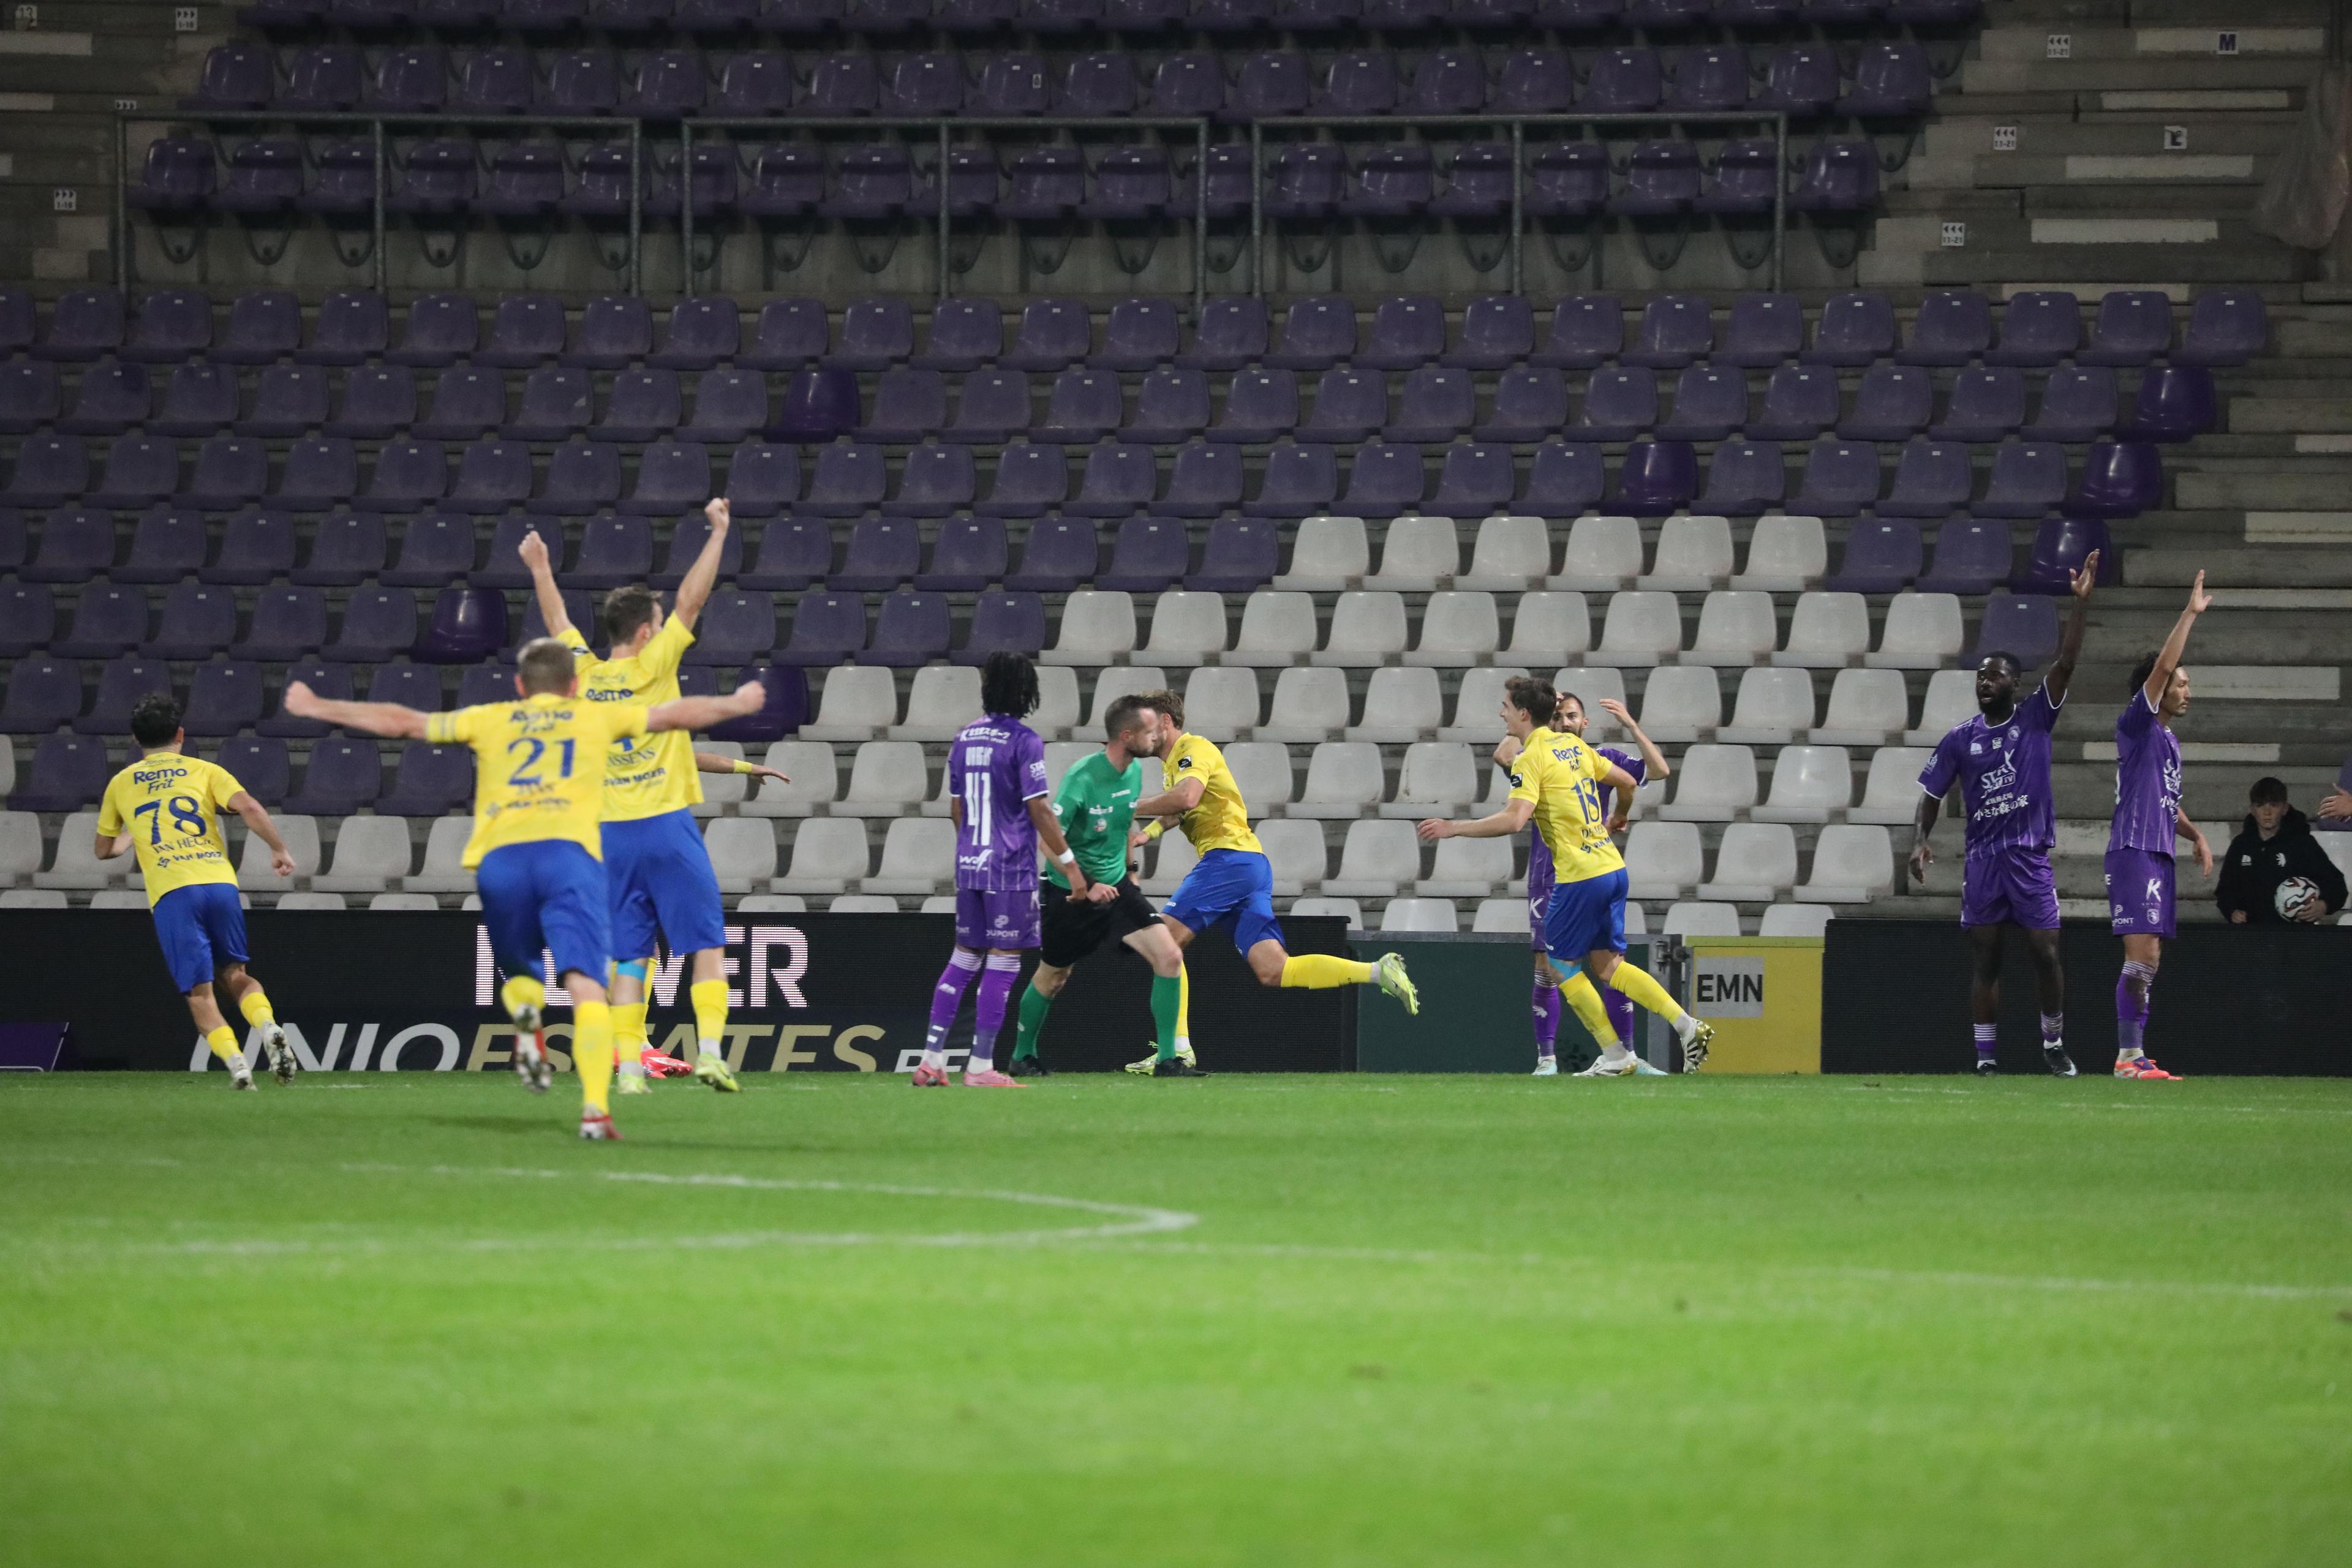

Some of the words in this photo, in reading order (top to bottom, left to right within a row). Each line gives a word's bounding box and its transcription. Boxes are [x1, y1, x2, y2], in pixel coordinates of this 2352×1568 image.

[2219, 34, 2236, 50] M
[507, 737, 576, 785] 21
[134, 768, 187, 785] Remo
[147, 778, 174, 794] Frit
[965, 772, 991, 846] 41
[1570, 778, 1603, 825] 18
[134, 796, 207, 845] 78
[2146, 878, 2162, 902] K
[1697, 974, 1763, 1003] EMN
